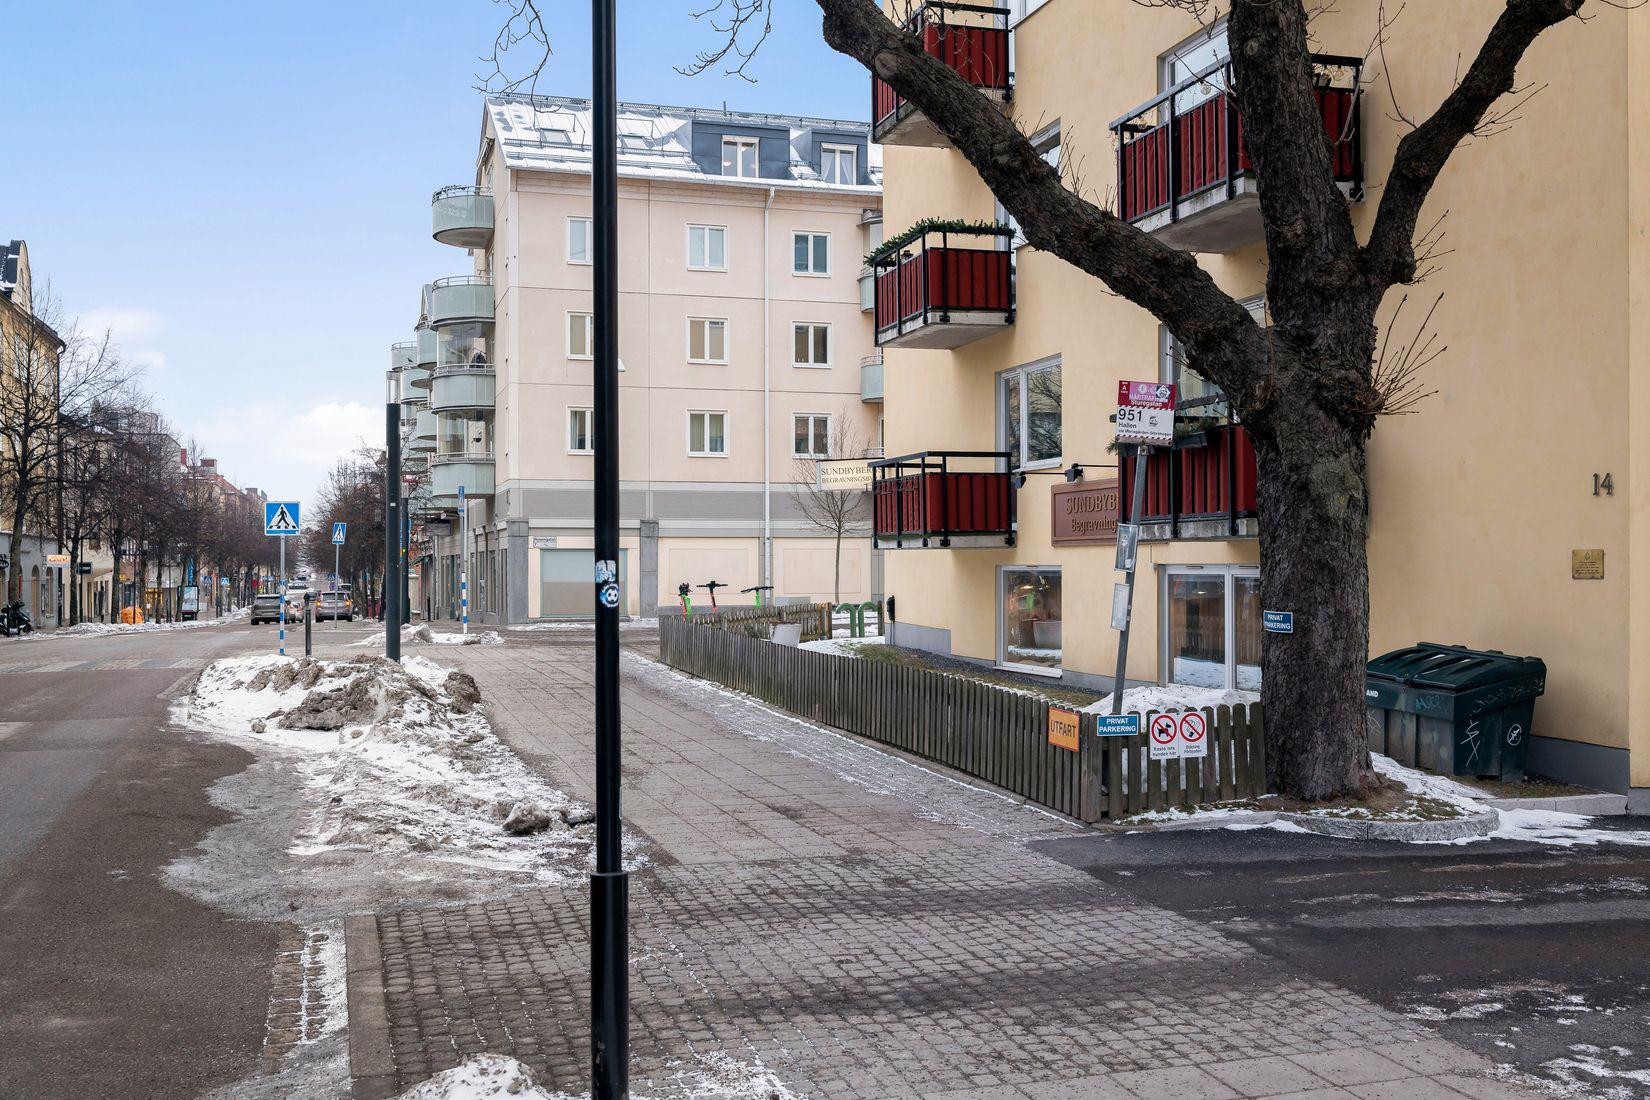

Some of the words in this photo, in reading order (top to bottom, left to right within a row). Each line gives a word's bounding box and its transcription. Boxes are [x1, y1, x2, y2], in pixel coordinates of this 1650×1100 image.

[1118, 408, 1142, 422] 951
[821, 476, 872, 484] BEGRAVNINGSBY
[1592, 472, 1614, 496] 14
[1066, 493, 1117, 515] SUNDBYB
[1071, 516, 1117, 535] Begravning
[1050, 720, 1077, 738] UTFART
[1099, 725, 1137, 733] PARKERING
[1106, 717, 1129, 725] PRIVAT
